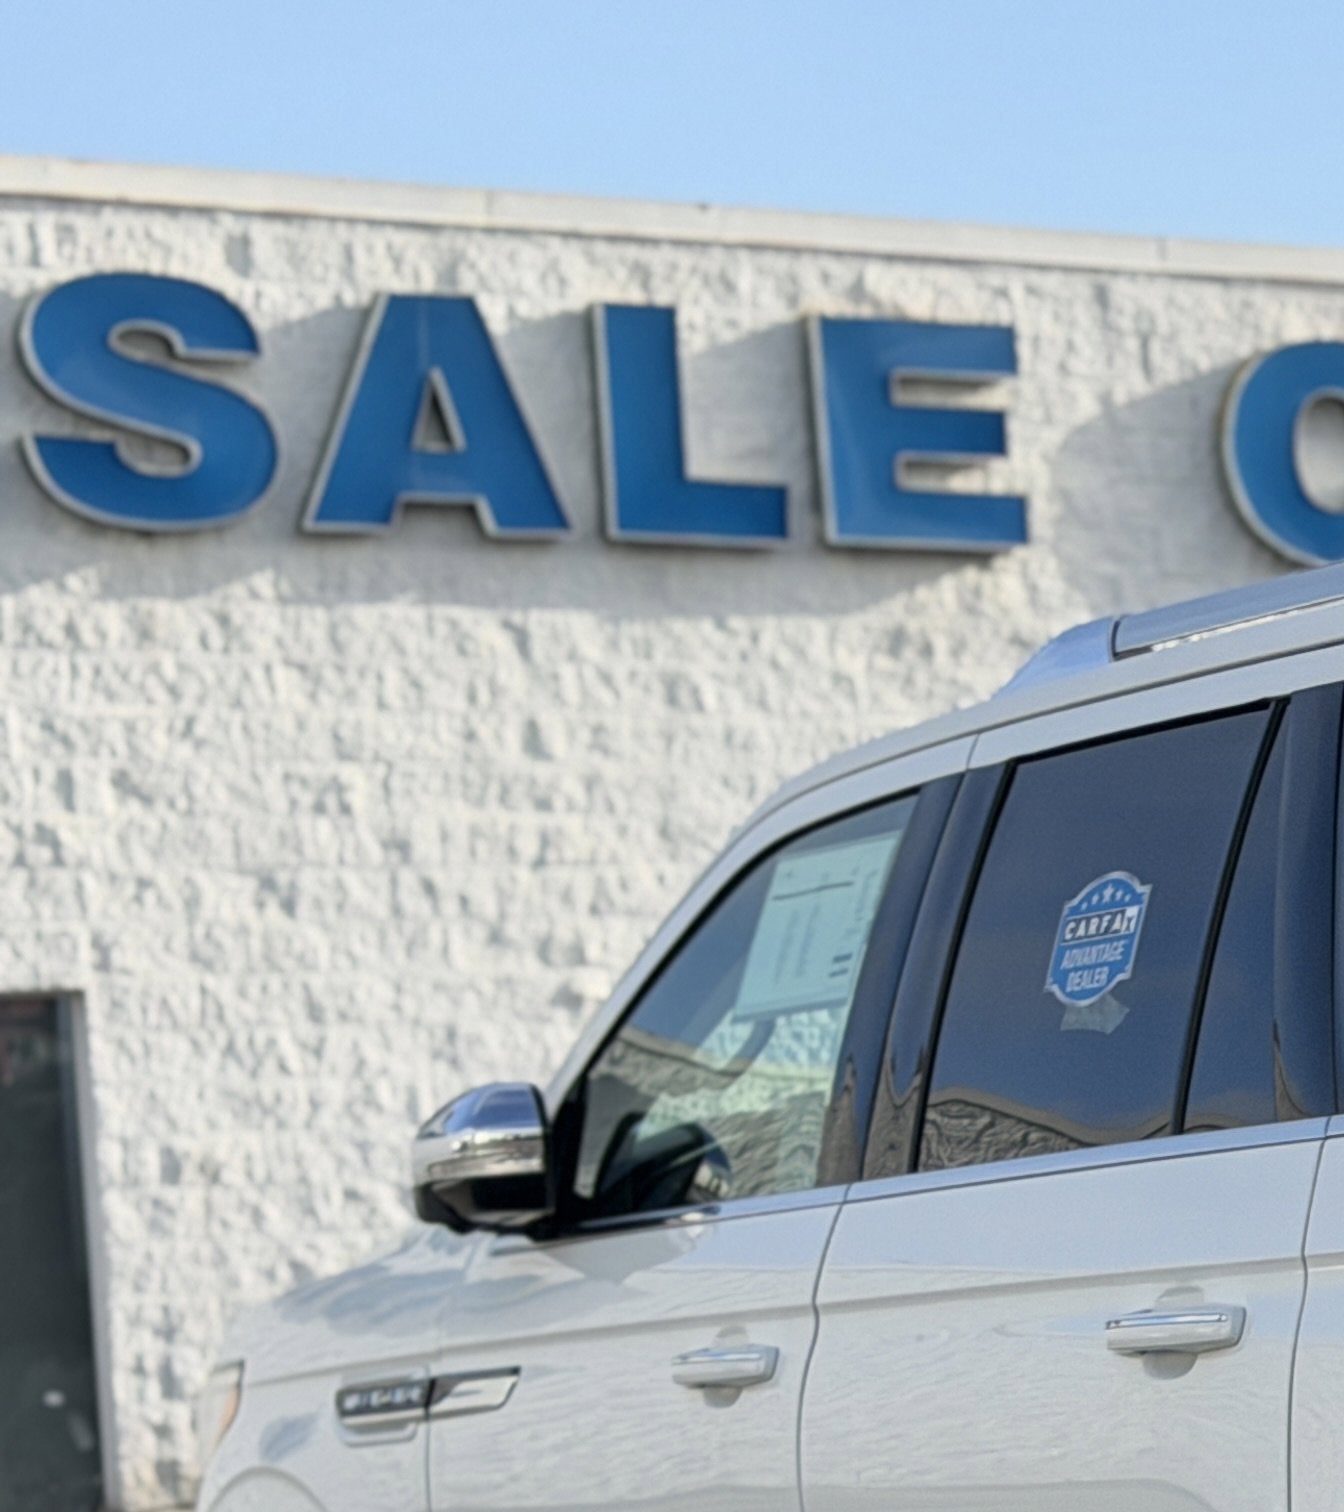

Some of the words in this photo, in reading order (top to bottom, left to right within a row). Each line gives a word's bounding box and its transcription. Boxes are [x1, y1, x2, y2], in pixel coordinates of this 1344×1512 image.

[19, 271, 1028, 550] SALE
[1064, 910, 1137, 940] CARFAX
[1066, 966, 1110, 993] DEALER
